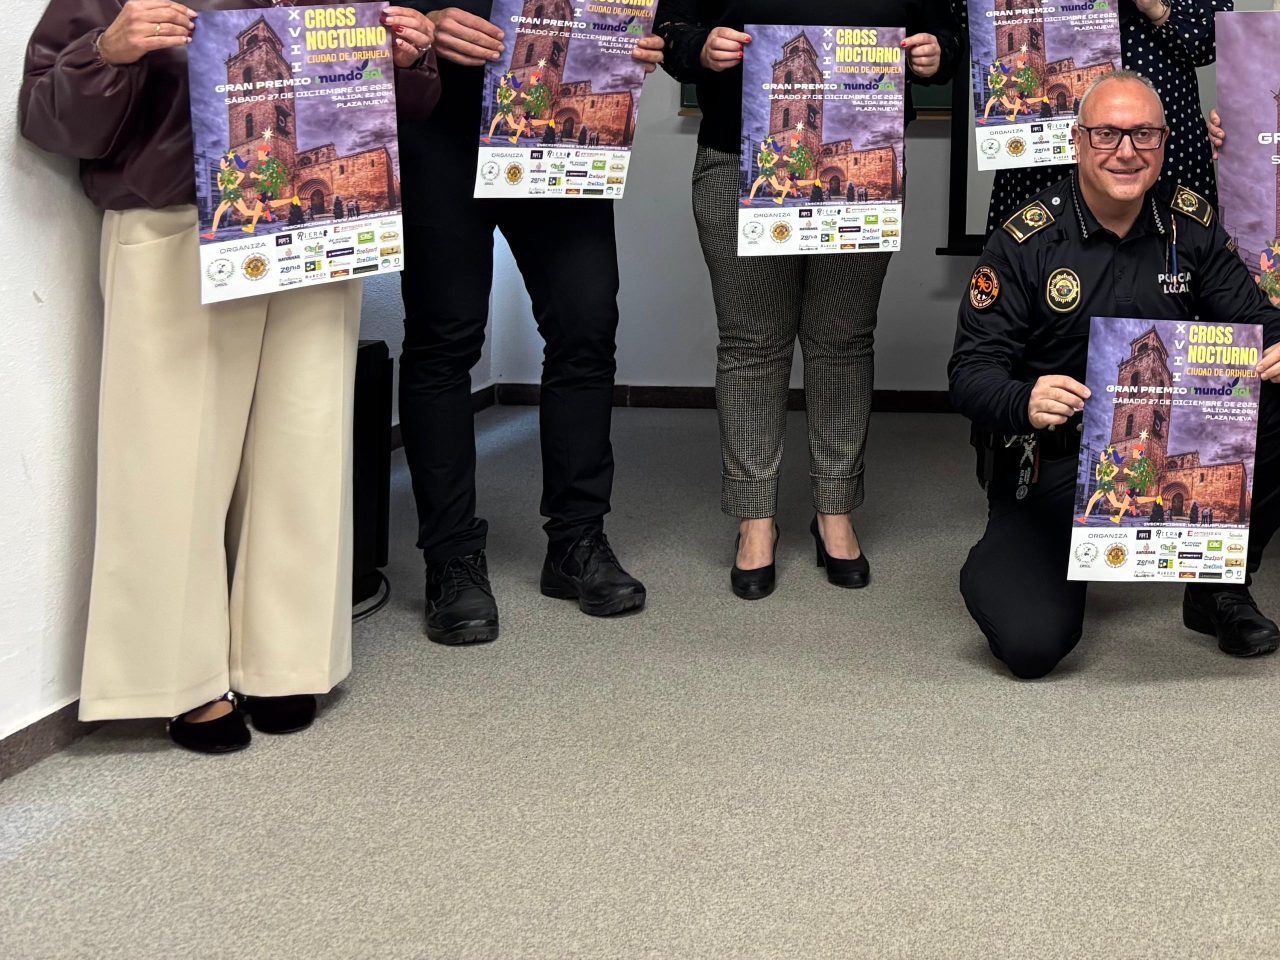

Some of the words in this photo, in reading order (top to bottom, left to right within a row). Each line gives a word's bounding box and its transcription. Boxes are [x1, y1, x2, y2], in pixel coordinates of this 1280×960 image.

[304, 7, 356, 29] CROSS
[986, 9, 1013, 17] GRAN
[1015, 7, 1055, 15] PREMIO
[510, 15, 541, 24] GRAN
[542, 19, 587, 29] PREMIO
[306, 26, 387, 51] NOCTURNO
[836, 29, 877, 45] CROSS
[307, 53, 337, 64] CIUDAD
[339, 52, 349, 61] DE
[352, 49, 390, 60] ORIHUELA
[836, 46, 901, 63] NOCTURNO
[215, 82, 253, 93] GRAN
[256, 77, 311, 89] PREMIO
[296, 87, 353, 98] DICIEMBRE
[220, 242, 266, 254] ORGANIZA
[1189, 325, 1234, 344] CROSS
[1187, 345, 1259, 366] NOCTURNO
[1186, 368, 1212, 376] CIUDAD
[1106, 384, 1138, 393] GRAN
[1140, 386, 1187, 395] PREMIO
